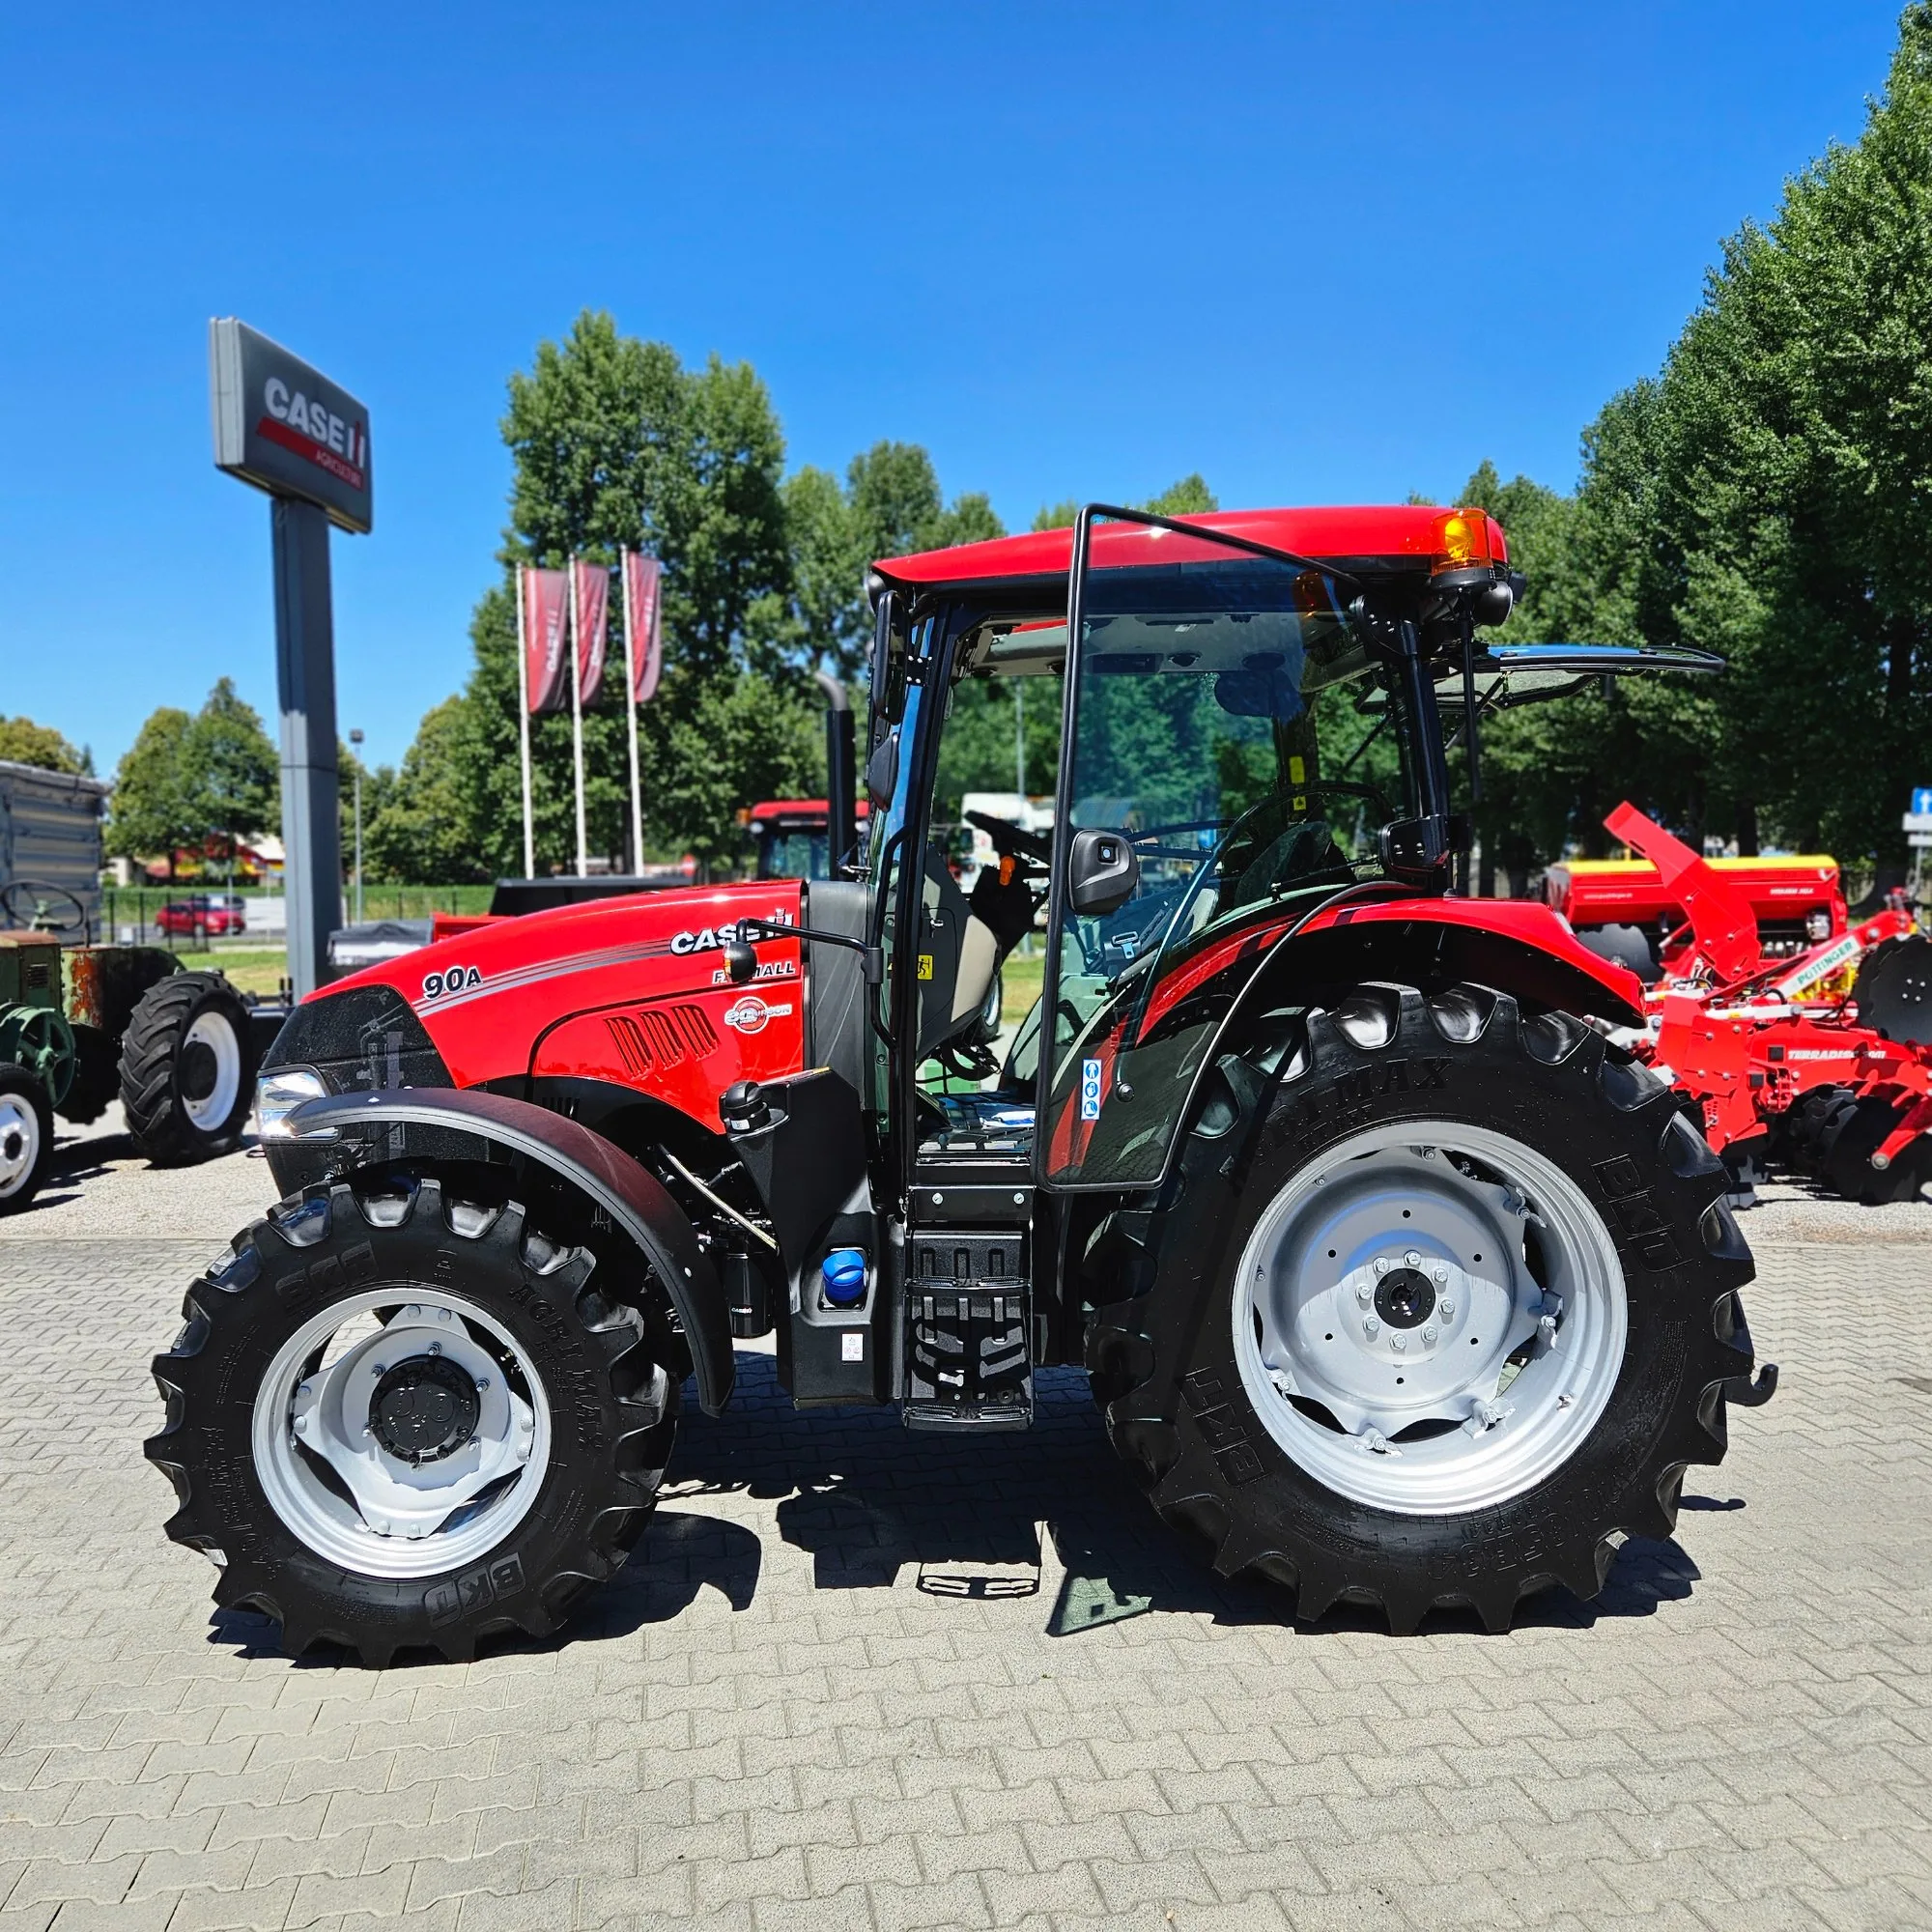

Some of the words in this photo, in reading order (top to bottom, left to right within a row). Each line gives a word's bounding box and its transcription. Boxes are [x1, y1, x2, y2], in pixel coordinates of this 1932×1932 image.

[265, 377, 345, 453] CASE
[422, 966, 483, 1000] 90A
[713, 962, 794, 982] FMALL
[423, 1551, 526, 1629] BKT
